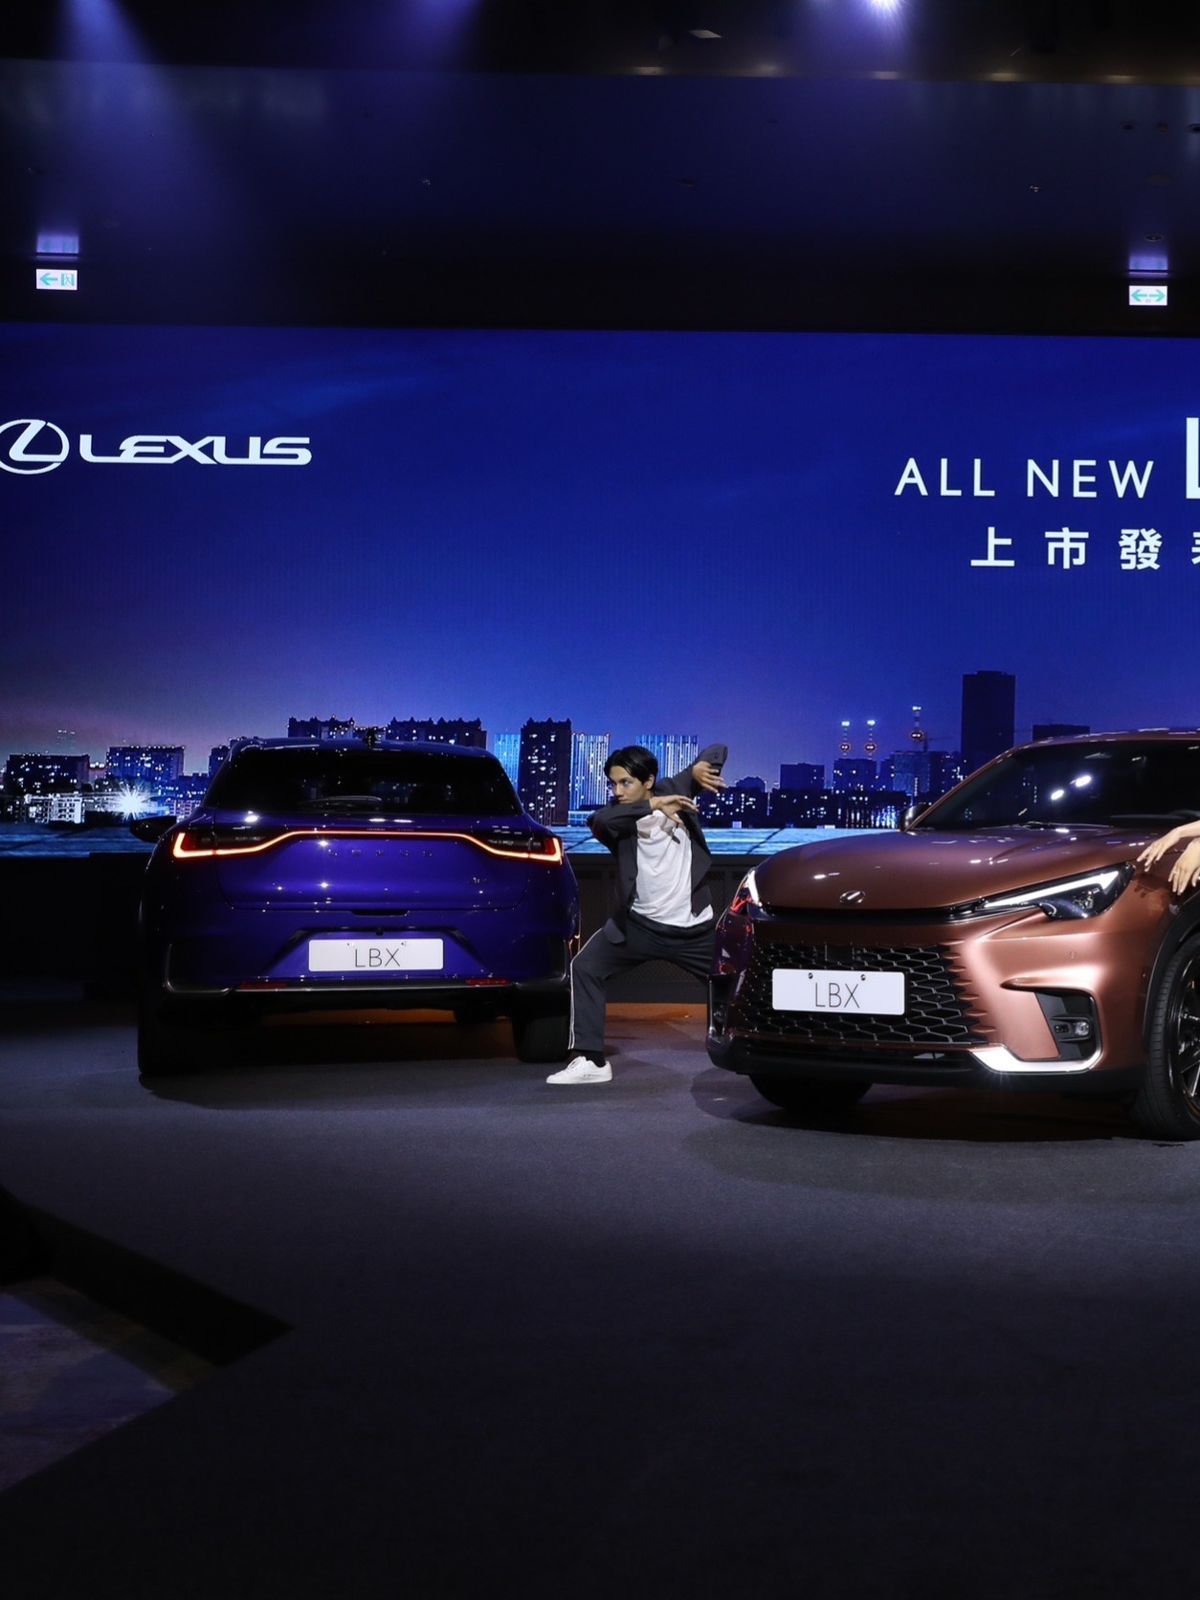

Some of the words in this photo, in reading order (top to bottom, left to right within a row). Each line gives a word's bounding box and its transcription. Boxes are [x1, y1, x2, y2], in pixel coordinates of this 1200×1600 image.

[80, 434, 312, 465] LEXUS
[895, 457, 996, 497] ALL
[1028, 459, 1154, 499] NEW
[354, 948, 401, 968] LBX
[815, 982, 860, 1008] LBX
